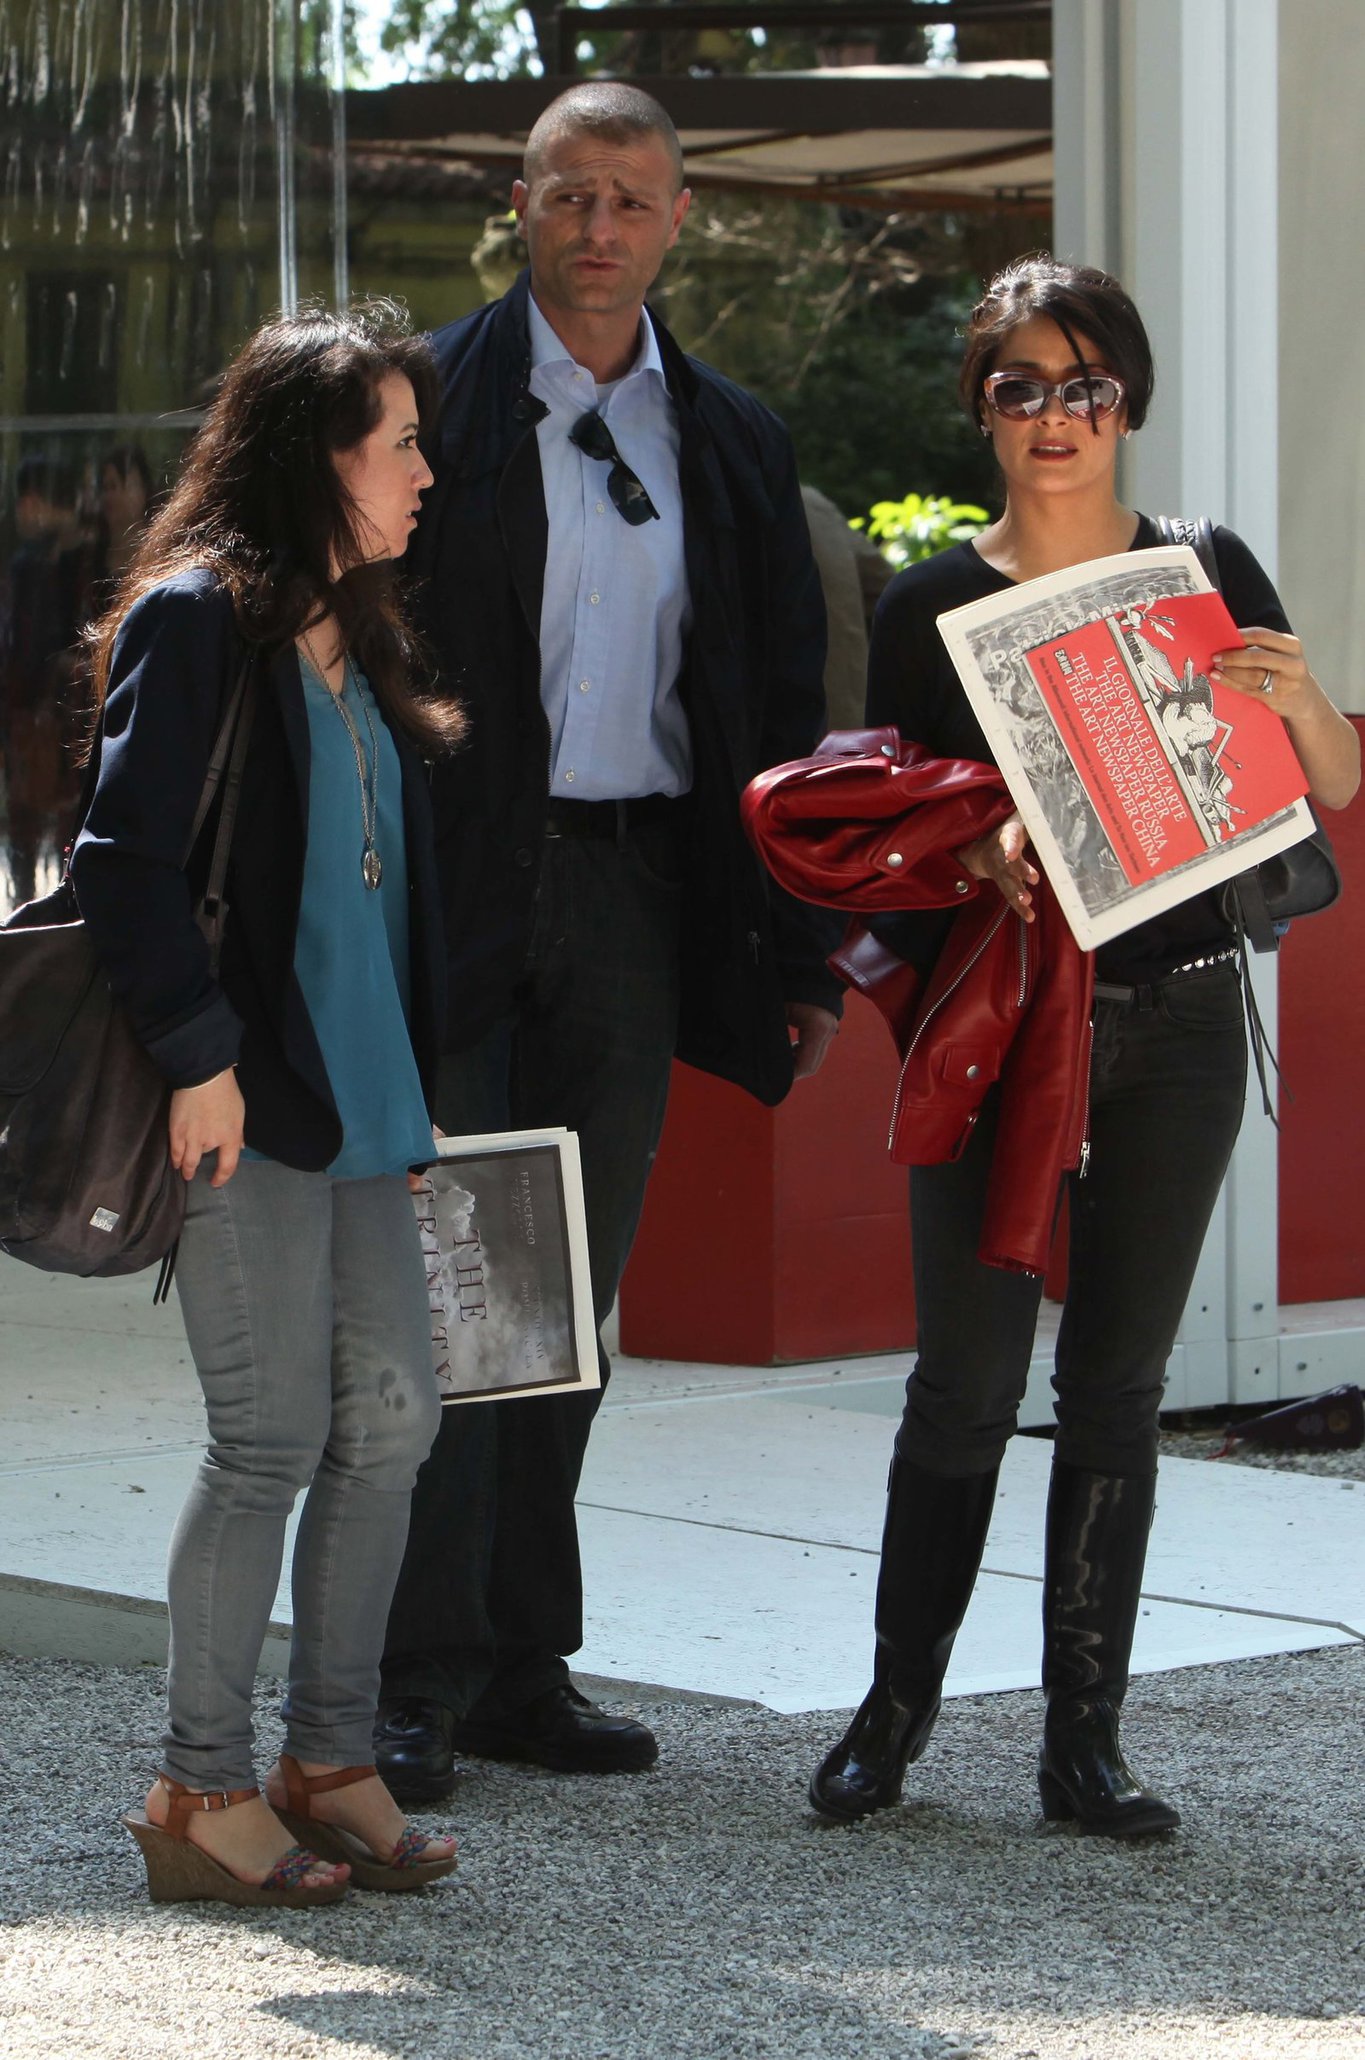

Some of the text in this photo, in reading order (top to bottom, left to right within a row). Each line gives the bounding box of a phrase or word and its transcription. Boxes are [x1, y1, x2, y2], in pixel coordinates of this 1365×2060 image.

[1066, 673, 1160, 867] THE ART NEWSPAPER CHINA
[1072, 652, 1168, 849] THE ART NEWSPAPER RUSSIA
[1095, 670, 1170, 820] THE ART NEWSPAPER
[1103, 656, 1187, 822] IL GIORNALE DELL'ARTE
[453, 1229, 488, 1322] THE
[520, 1171, 535, 1244] FRANCESCO
